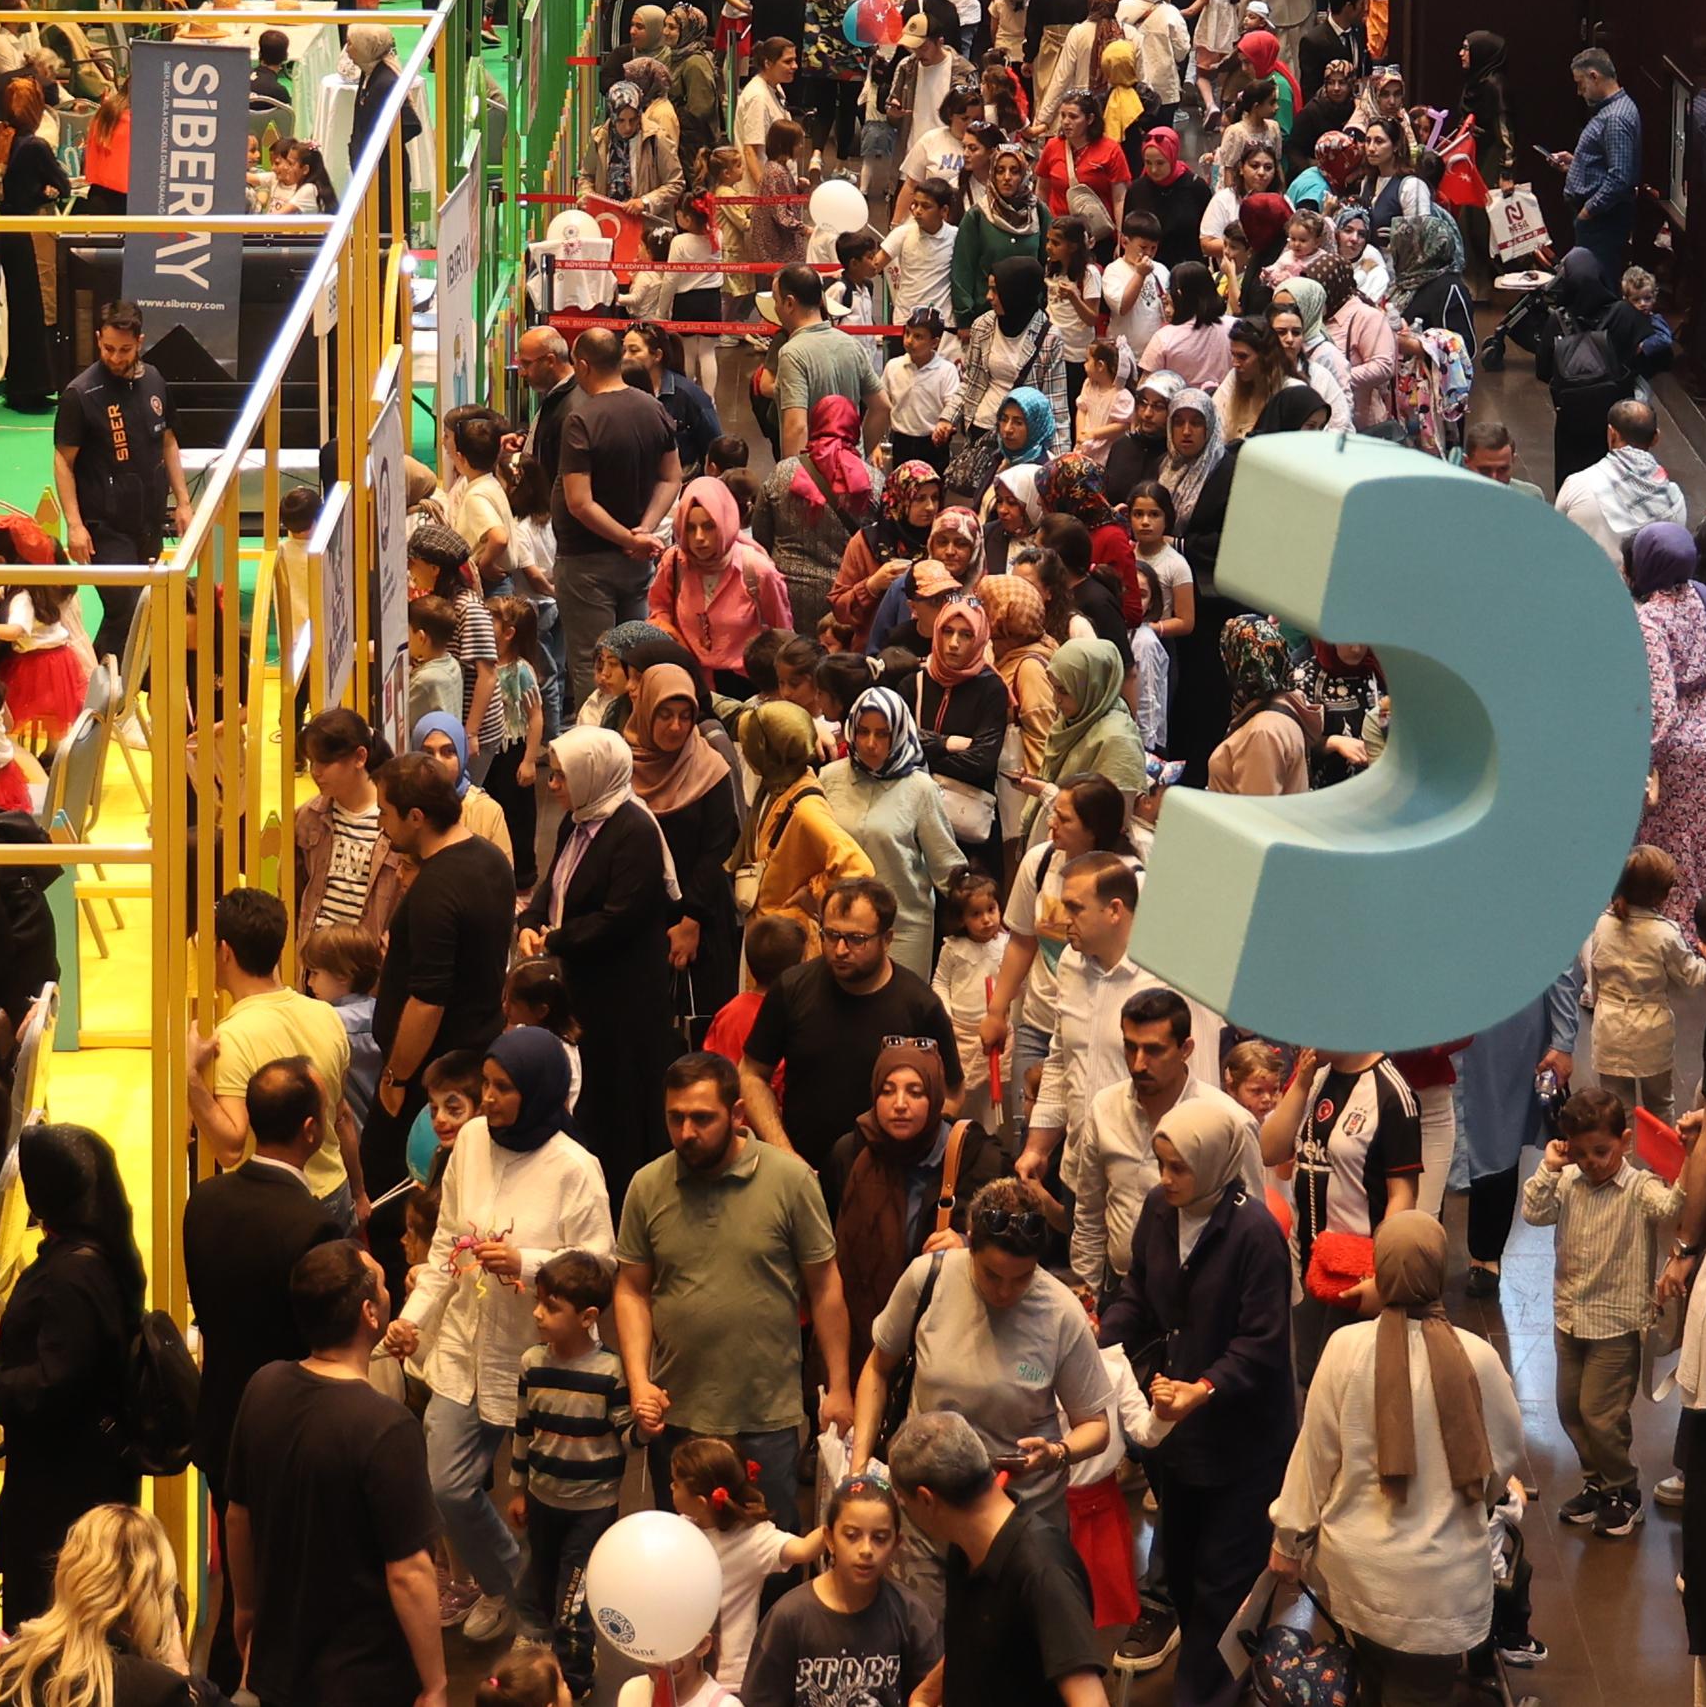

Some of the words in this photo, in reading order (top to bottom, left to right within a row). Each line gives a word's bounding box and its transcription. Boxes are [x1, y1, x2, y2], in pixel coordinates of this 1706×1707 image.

[612, 262, 651, 271] BELEDİYESİ
[690, 263, 717, 271] KÜLTÜR
[137, 298, 225, 312] www.siberay.com
